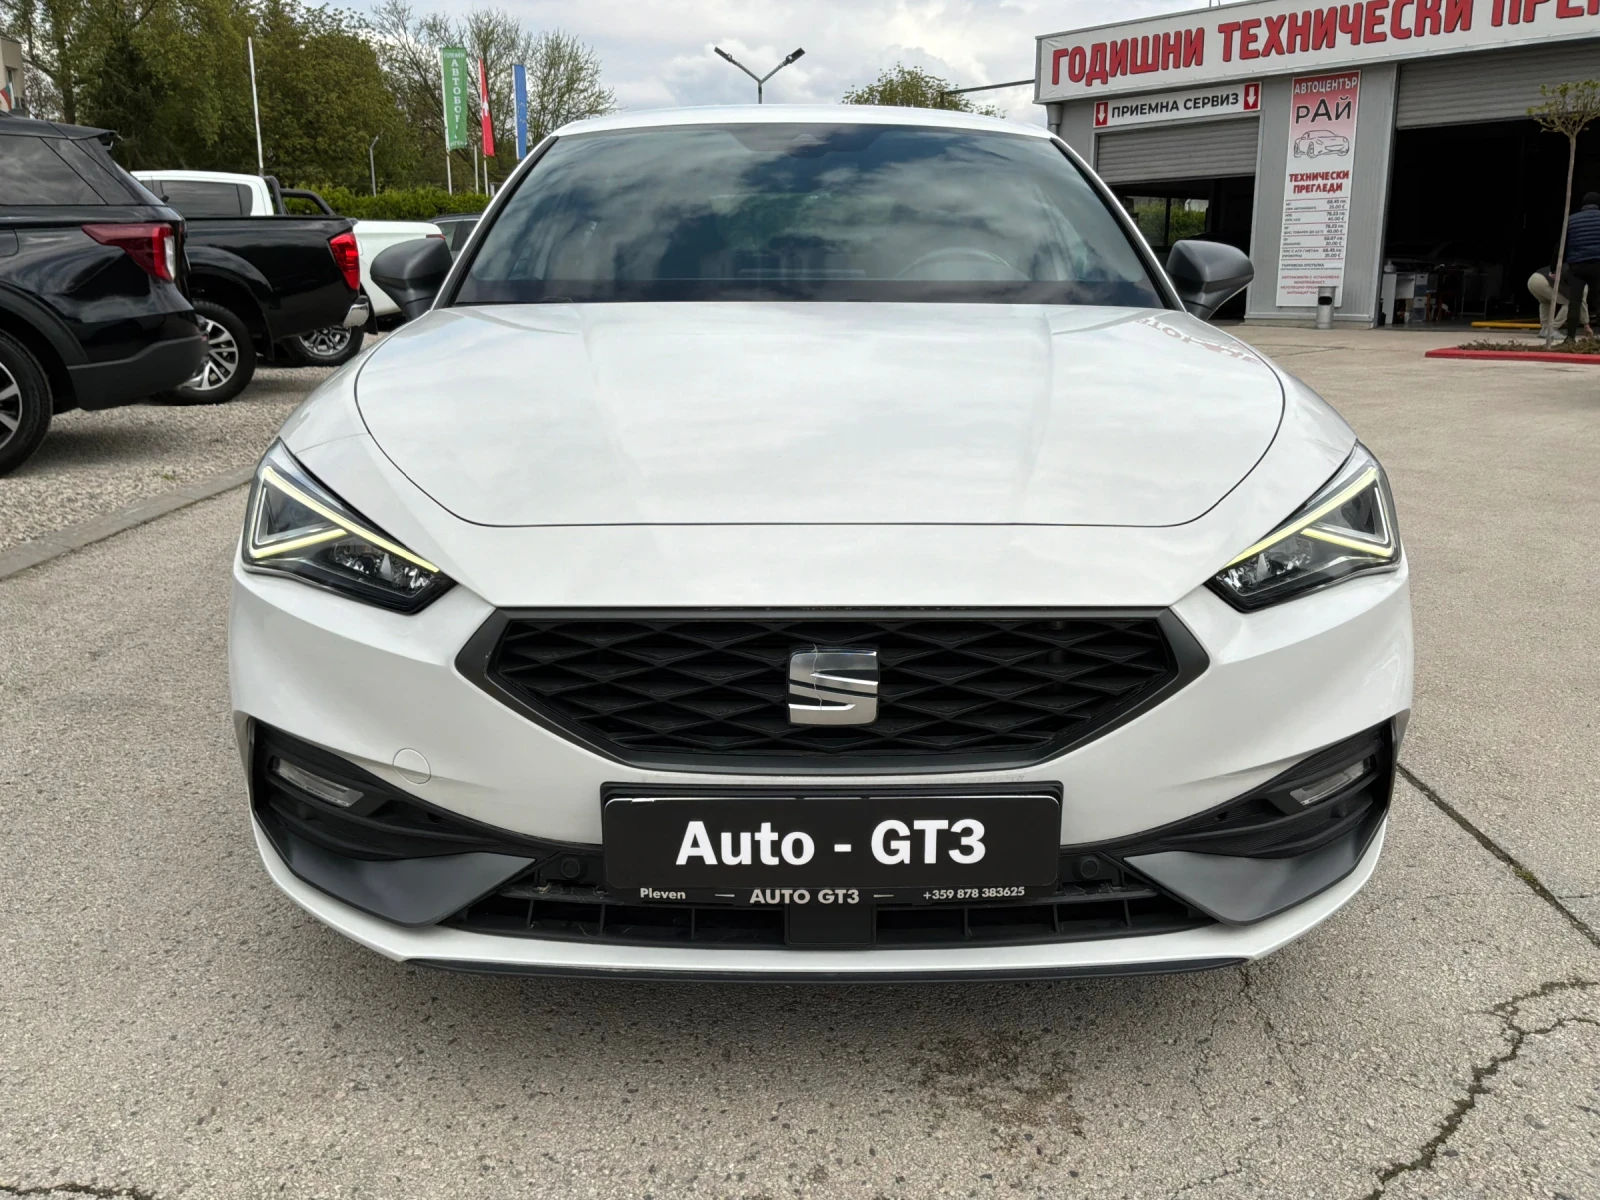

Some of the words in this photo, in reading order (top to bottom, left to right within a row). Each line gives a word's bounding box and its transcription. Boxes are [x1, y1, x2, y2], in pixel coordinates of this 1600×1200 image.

[1051, 27, 1205, 87] ГОДИШНИ
[1218, 0, 1473, 63] ТЕХНИЧЕСКИ
[1294, 77, 1358, 94] АВТОЦЕНТЪР
[1111, 100, 1180, 119] ПРИЕМНА
[1183, 92, 1239, 111] СЕРВИЗ
[1289, 170, 1350, 182] ТЕХНИЧЕСКИ
[1293, 182, 1343, 194] ПРЕГЛЕДИ
[675, 820, 815, 866] Auto
[871, 818, 986, 865] GT3
[640, 887, 686, 900] Pleven
[750, 889, 811, 904] AUTO
[817, 889, 860, 905] GT3
[923, 889, 955, 900] +359
[957, 889, 979, 899] 878
[982, 886, 1025, 897] 383625
